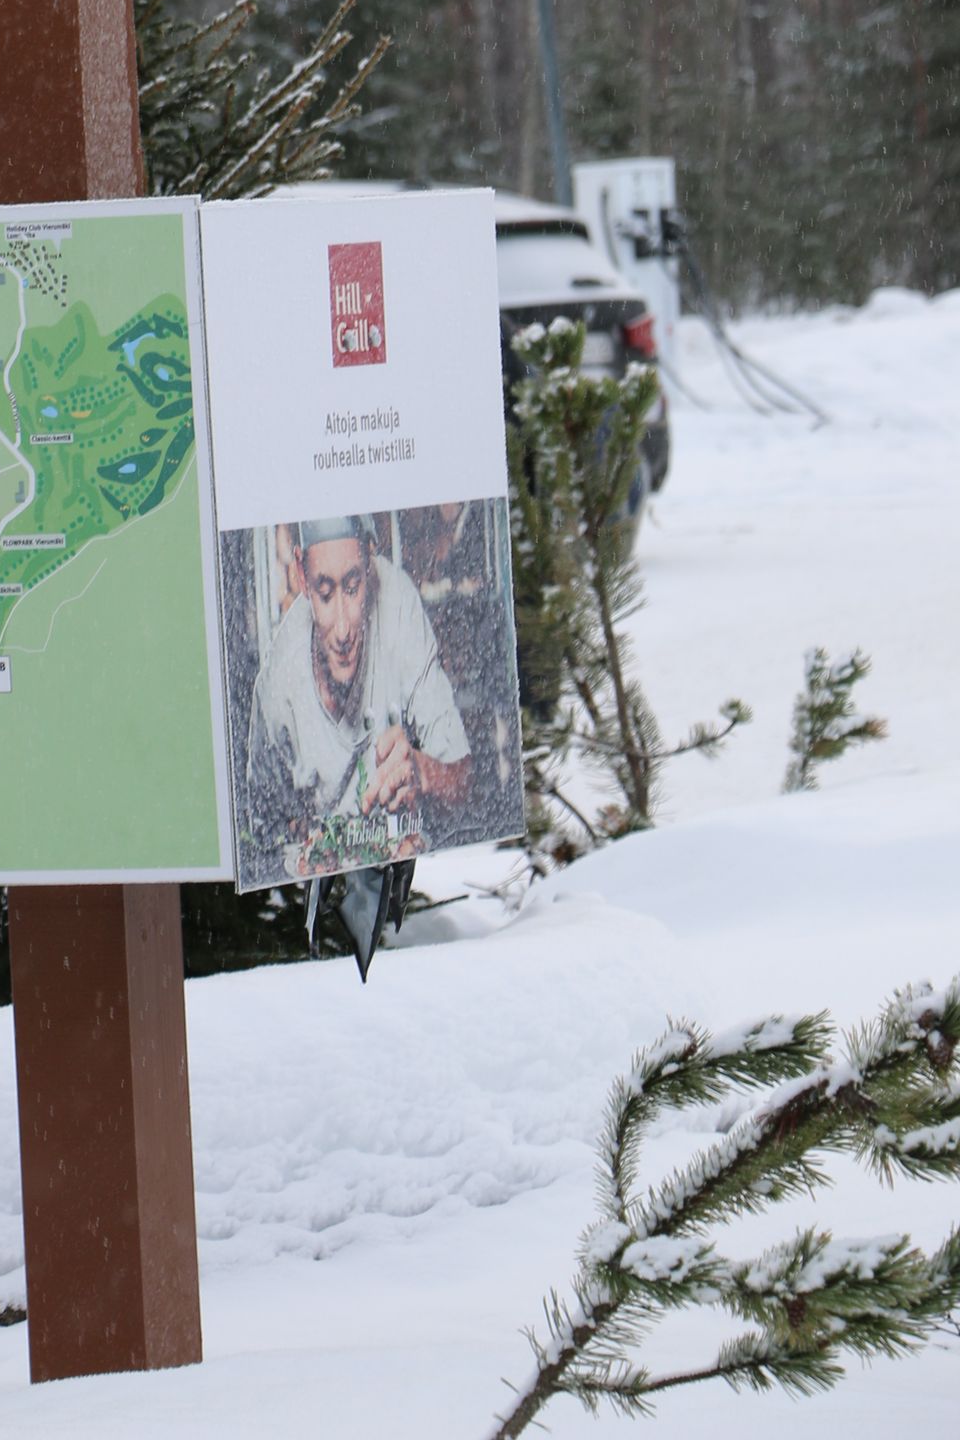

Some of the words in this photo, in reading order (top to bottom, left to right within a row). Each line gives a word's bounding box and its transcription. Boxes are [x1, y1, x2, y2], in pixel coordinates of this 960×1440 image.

[335, 281, 361, 315] Hill
[325, 411, 358, 438] Aitoja
[360, 406, 400, 434] makuja
[313, 444, 366, 471] rouhealla
[368, 438, 415, 465] twistillä!
[400, 809, 424, 836] Club
